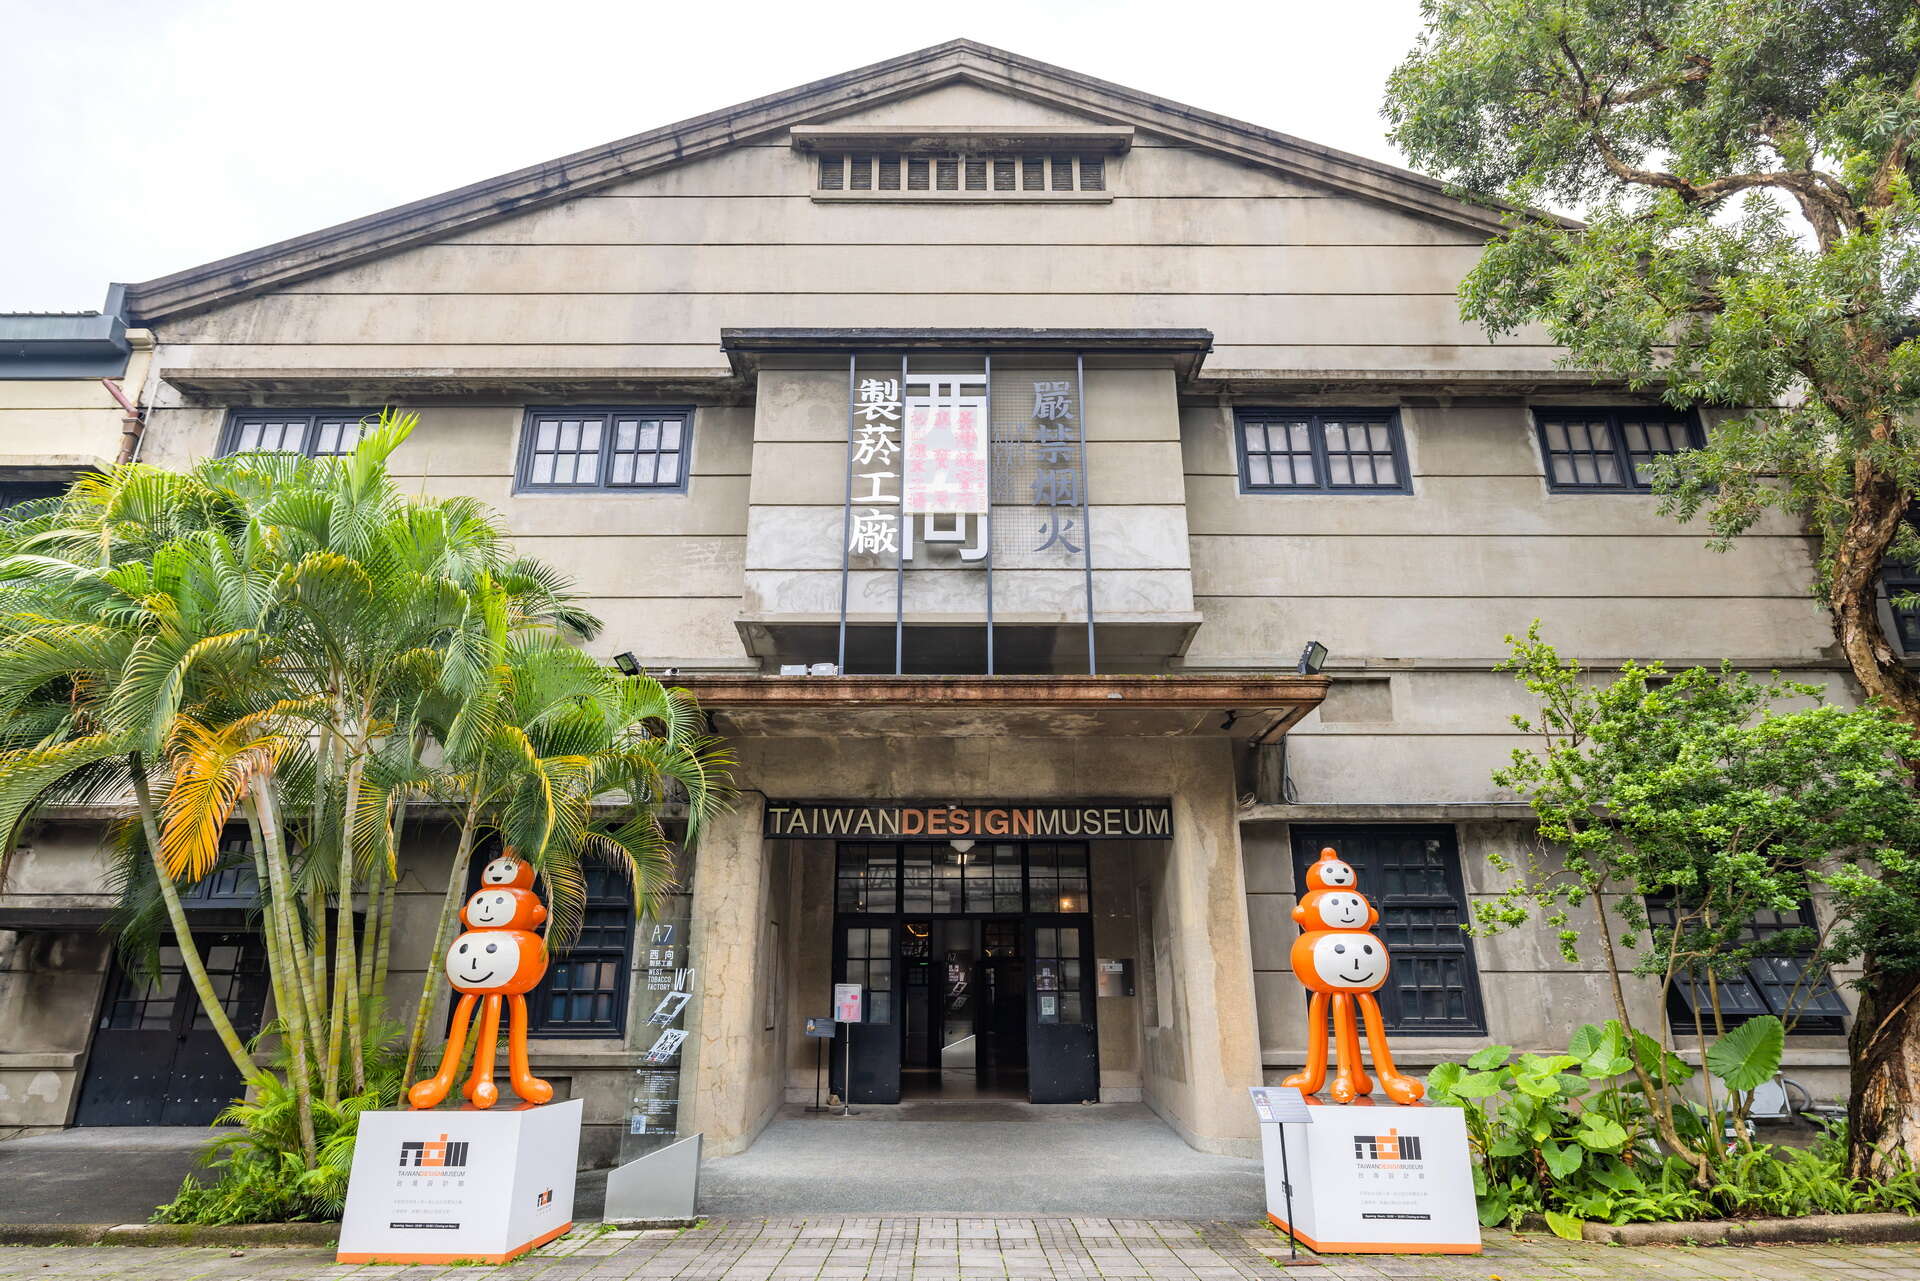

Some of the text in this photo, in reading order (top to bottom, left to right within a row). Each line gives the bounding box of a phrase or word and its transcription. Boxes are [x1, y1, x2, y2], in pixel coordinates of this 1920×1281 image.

[848, 378, 903, 553] 製菸工廠
[651, 924, 673, 943] A7
[648, 968, 663, 976] WEST
[674, 967, 695, 992] W1
[647, 983, 671, 991] FACTORY
